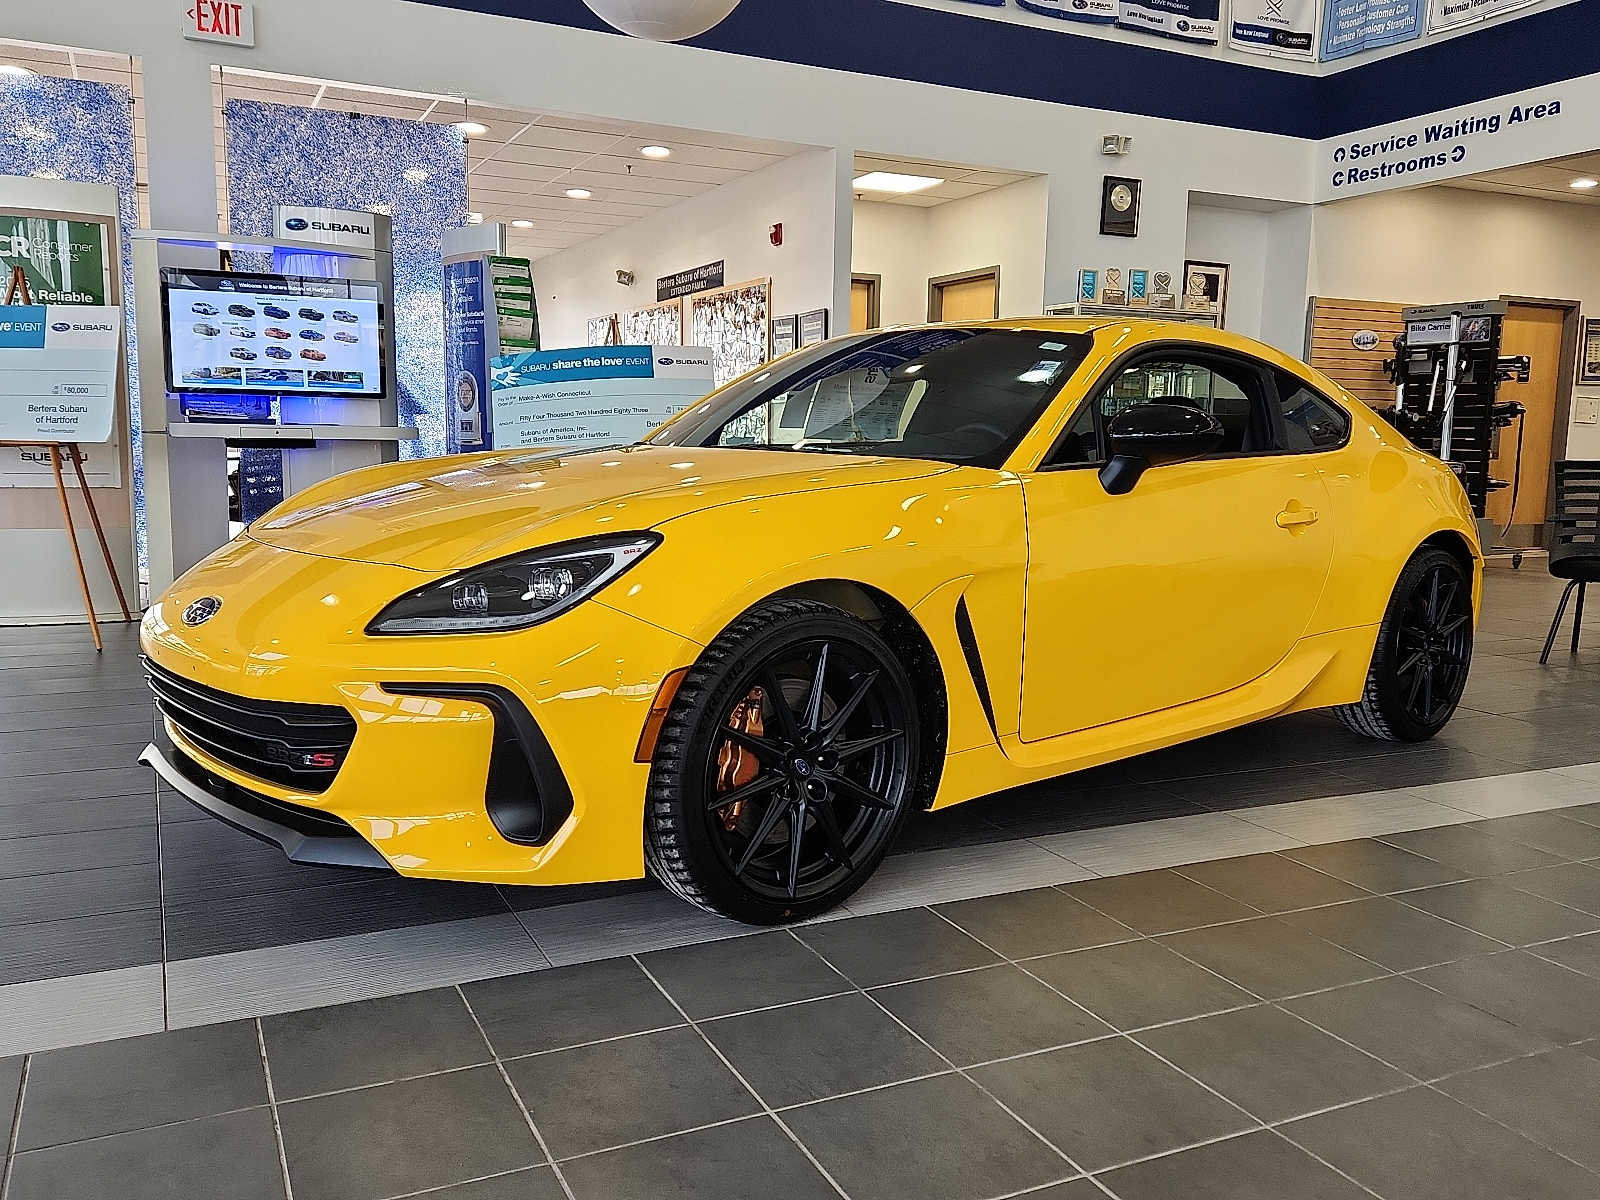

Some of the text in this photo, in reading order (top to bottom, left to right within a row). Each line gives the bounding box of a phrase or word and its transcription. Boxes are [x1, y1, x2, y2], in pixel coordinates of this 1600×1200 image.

[1367, 8, 1396, 22] Customer
[1396, 3, 1409, 14] Care
[1443, 2, 1470, 17] Maximize
[196, 0, 242, 37] EXIT
[1386, 15, 1416, 31] Strengths
[1349, 100, 1562, 160] Service Waiting Area
[1347, 151, 1447, 185] Restrooms
[311, 220, 370, 236] SUBARU
[33, 237, 94, 253] Consumer
[33, 248, 80, 263] Reports
[658, 262, 723, 290] Bertera Subaru of Hartford
[670, 279, 708, 297] EXTENDED FAMILY
[38, 289, 94, 303] Reliable
[14, 322, 42, 332] EVENT
[73, 324, 113, 332] SUBARU
[1410, 322, 1451, 332] Bike Carrie
[521, 356, 649, 374] SUBARU share the love EVENT
[518, 389, 592, 402] Make-A-Wish Connecticut
[28, 404, 88, 413] Bertera Subaru
[519, 415, 532, 423] Fifty
[532, 413, 546, 421] Four
[547, 410, 575, 419] Thousand
[587, 407, 613, 416] Hundred
[613, 407, 632, 416] Eighty
[35, 415, 79, 424] of Hartford
[520, 429, 542, 438] Subaru
[542, 427, 549, 435] of
[520, 437, 532, 445] and
[555, 433, 577, 442] Subaru
